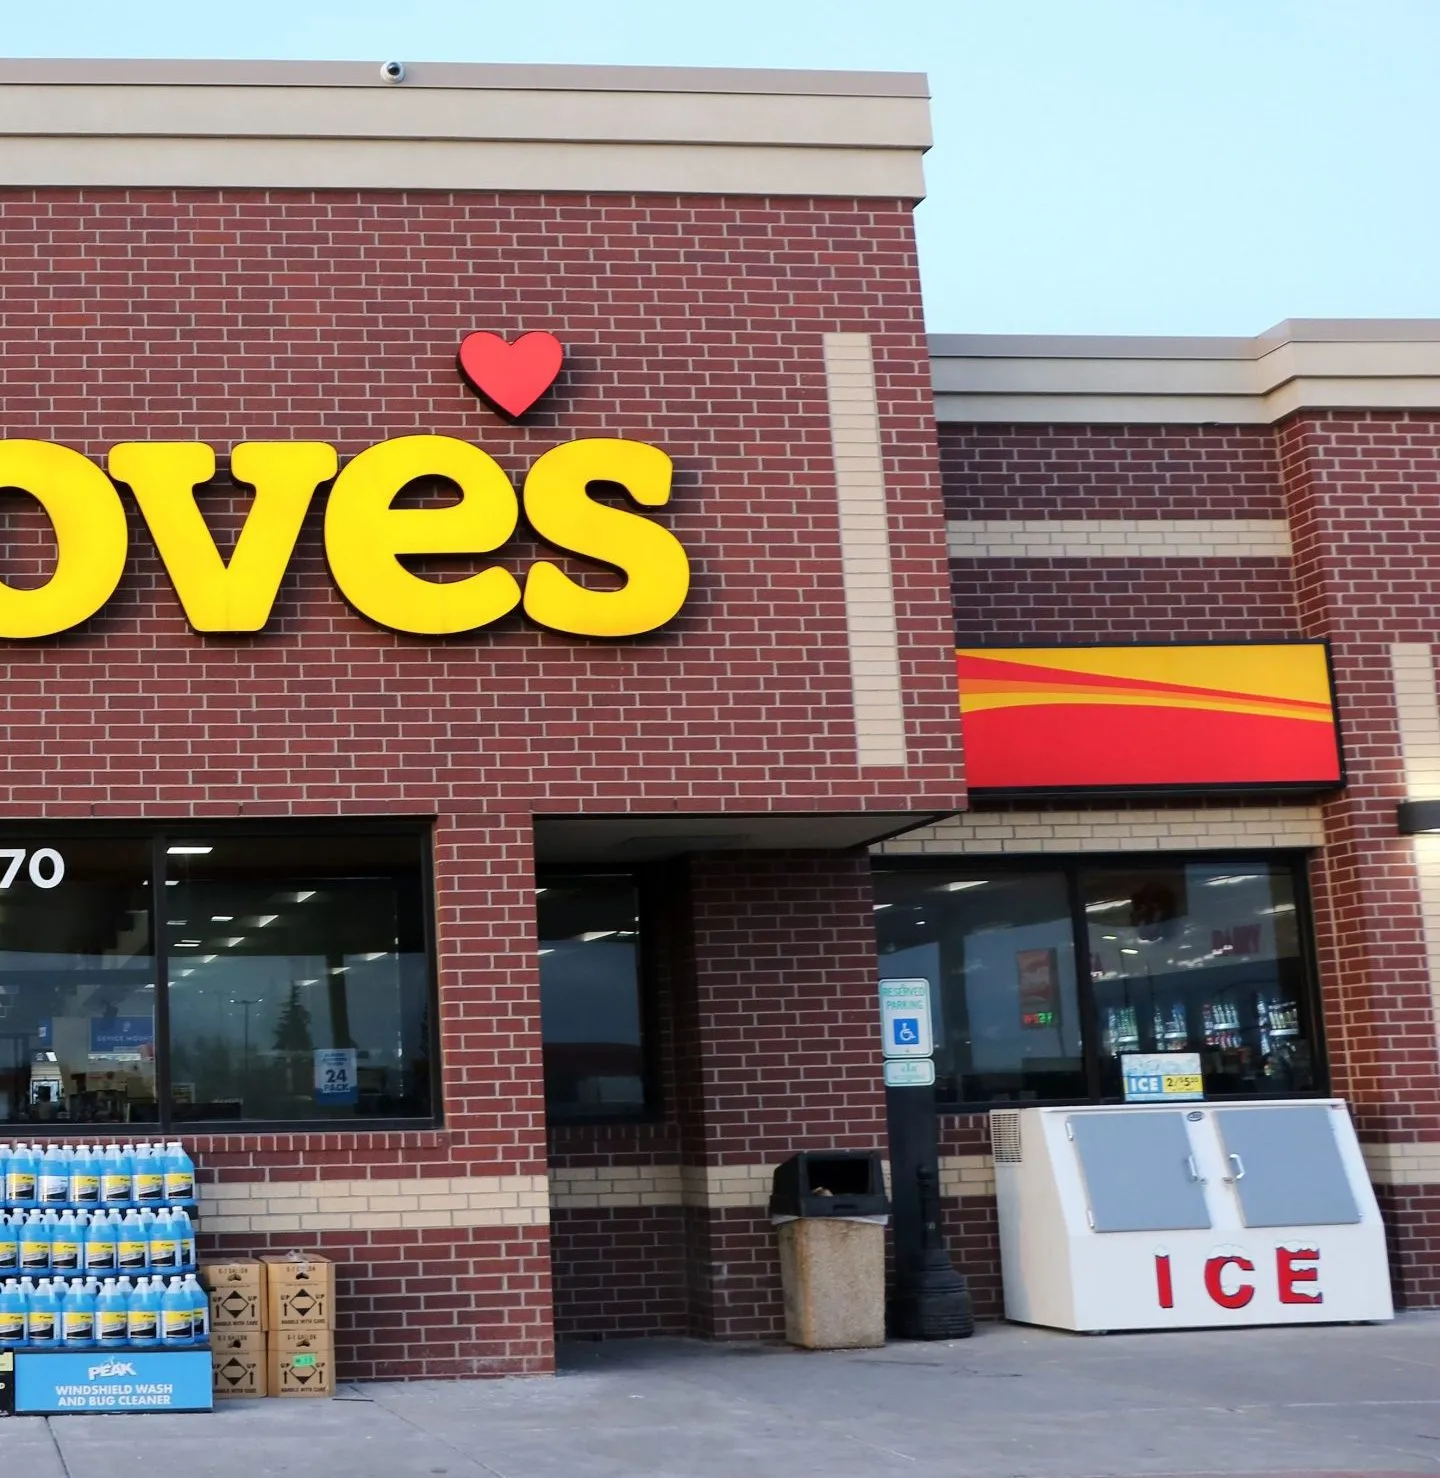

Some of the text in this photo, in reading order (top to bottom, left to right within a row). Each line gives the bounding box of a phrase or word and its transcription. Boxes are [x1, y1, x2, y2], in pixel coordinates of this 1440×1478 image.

[326, 1069, 349, 1084] 24
[1130, 1077, 1159, 1093] ICE
[1153, 1240, 1324, 1309] ICE
[88, 1361, 137, 1381] PEAK
[56, 1384, 173, 1396] WINDSHIELD WASH
[58, 1395, 171, 1406] AND BUG CLEANER
